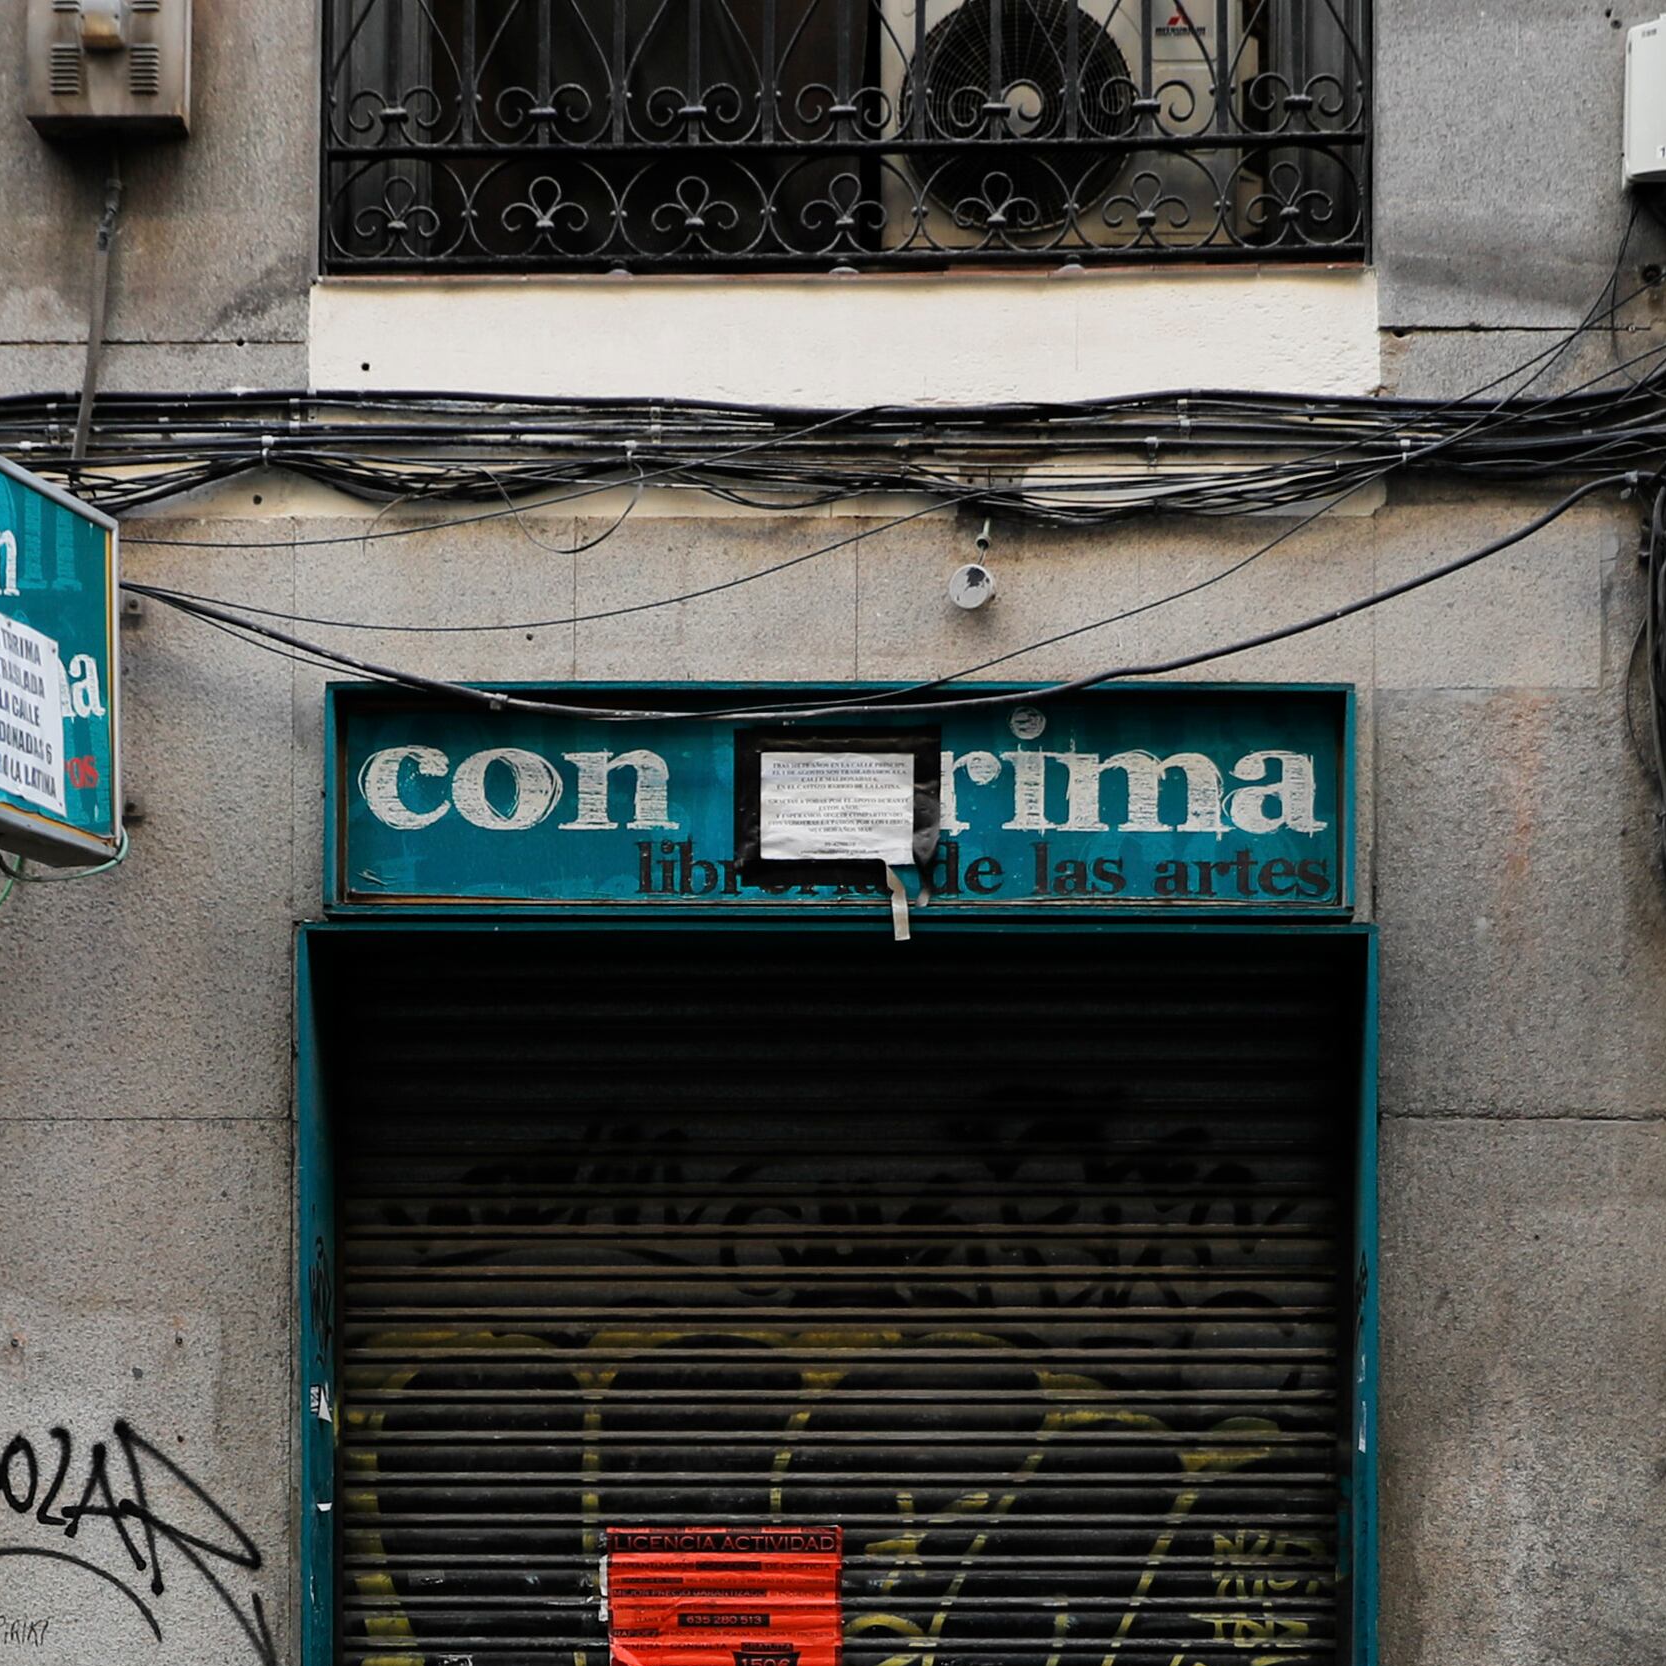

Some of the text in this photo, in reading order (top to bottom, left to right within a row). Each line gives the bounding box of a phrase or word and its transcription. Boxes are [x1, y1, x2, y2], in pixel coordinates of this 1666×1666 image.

[11, 692, 41, 727] CALLE
[45, 742, 53, 765] 6
[10, 758, 23, 785] LA
[24, 765, 57, 799] LATINA
[358, 745, 680, 831] con
[935, 841, 1003, 895] de
[1034, 843, 1129, 895] las
[1153, 847, 1332, 898] artes
[614, 1535, 835, 1551] LICENCIA ACTIVIDAD
[686, 1614, 762, 1625] 635 280 513
